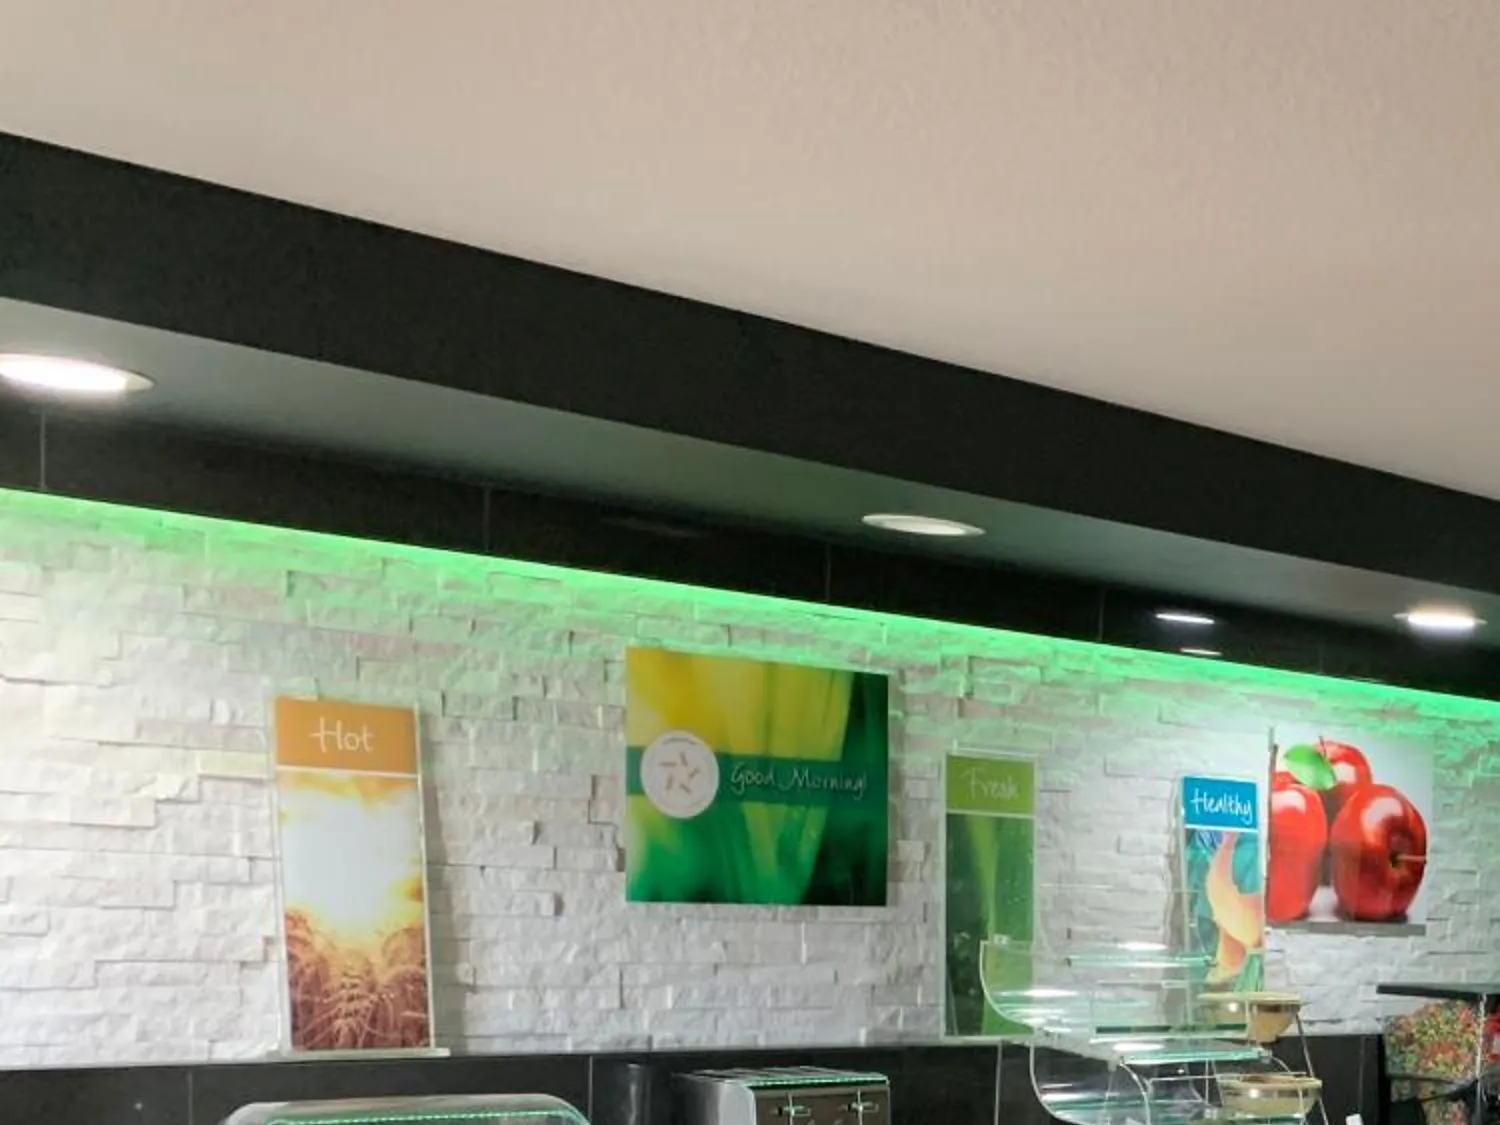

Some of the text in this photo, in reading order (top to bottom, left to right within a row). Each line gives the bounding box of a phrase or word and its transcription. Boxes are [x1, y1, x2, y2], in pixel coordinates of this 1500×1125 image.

[308, 715, 375, 754] Hot
[730, 762, 868, 801] Good Morning!
[1190, 787, 1253, 826] Healthy
